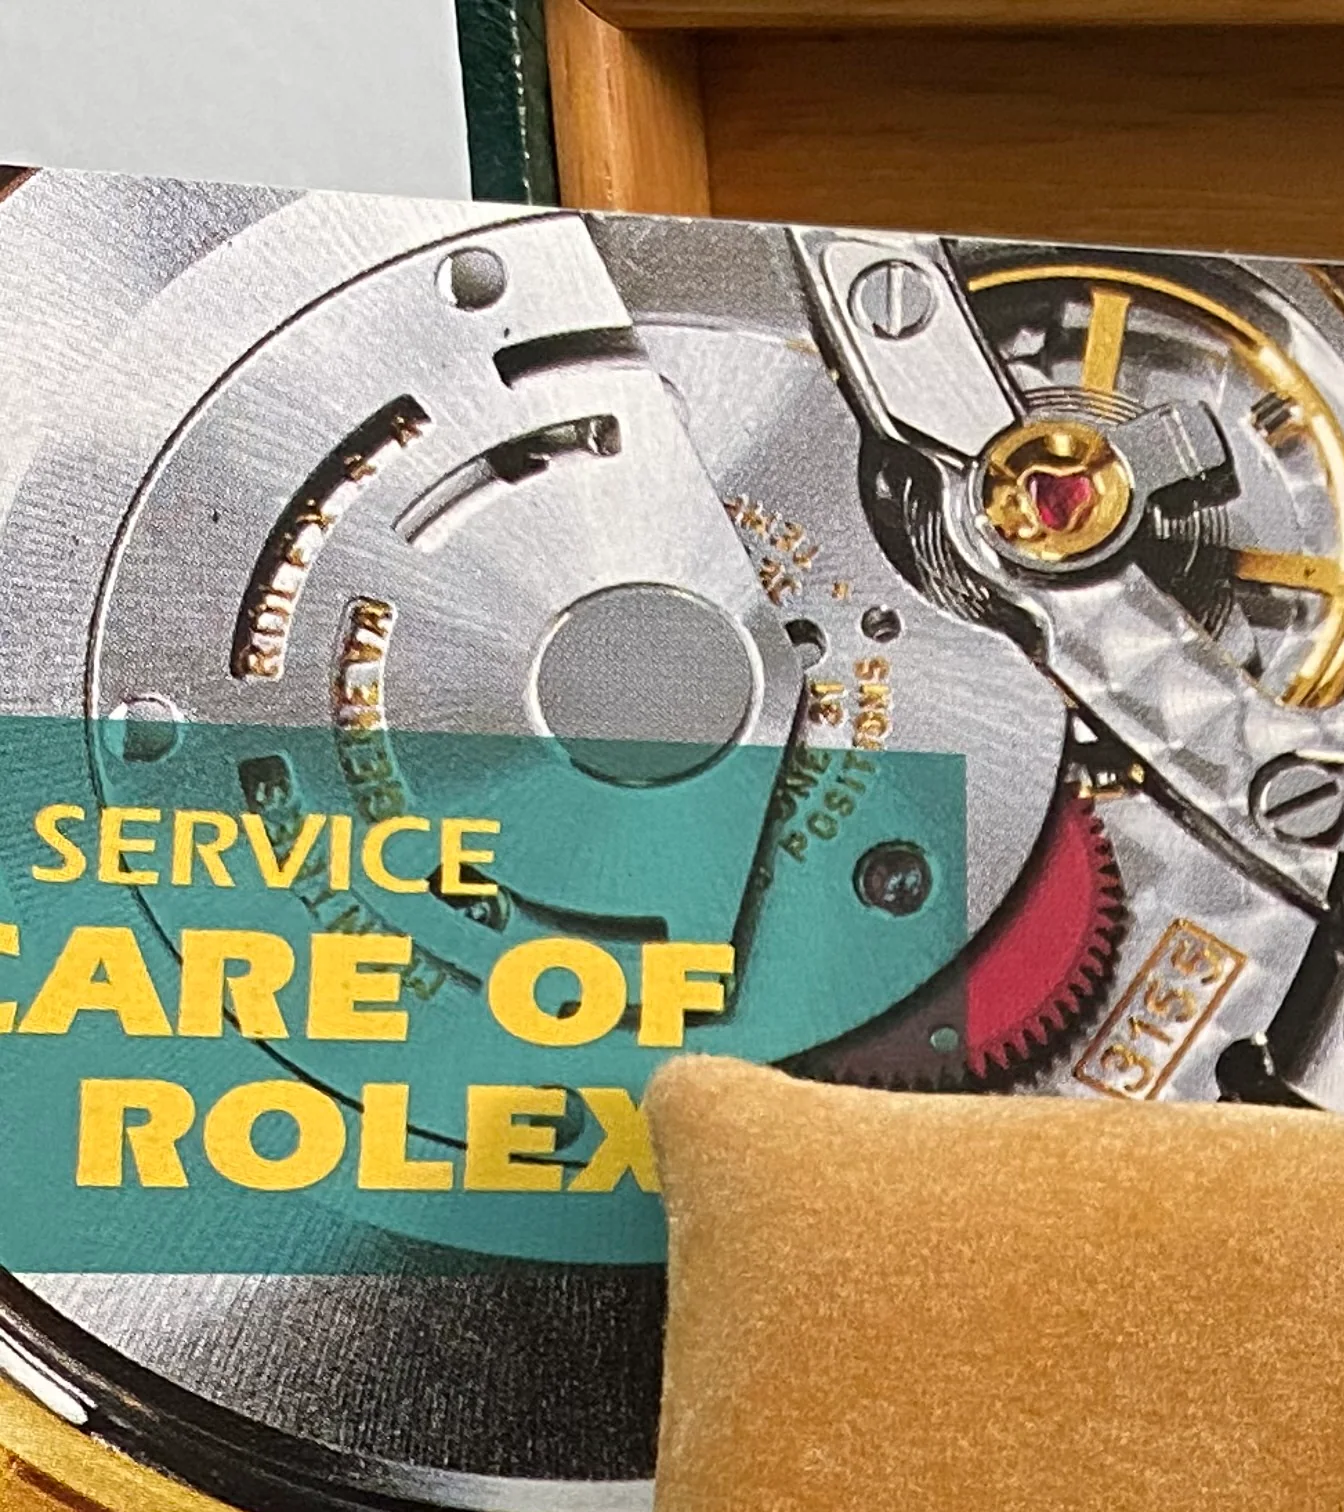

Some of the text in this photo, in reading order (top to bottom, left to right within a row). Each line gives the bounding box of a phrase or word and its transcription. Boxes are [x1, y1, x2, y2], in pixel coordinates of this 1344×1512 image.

[31, 804, 502, 895] SERVICE
[0, 923, 736, 1048] ARE OF
[75, 1078, 662, 1193] ROLEX
